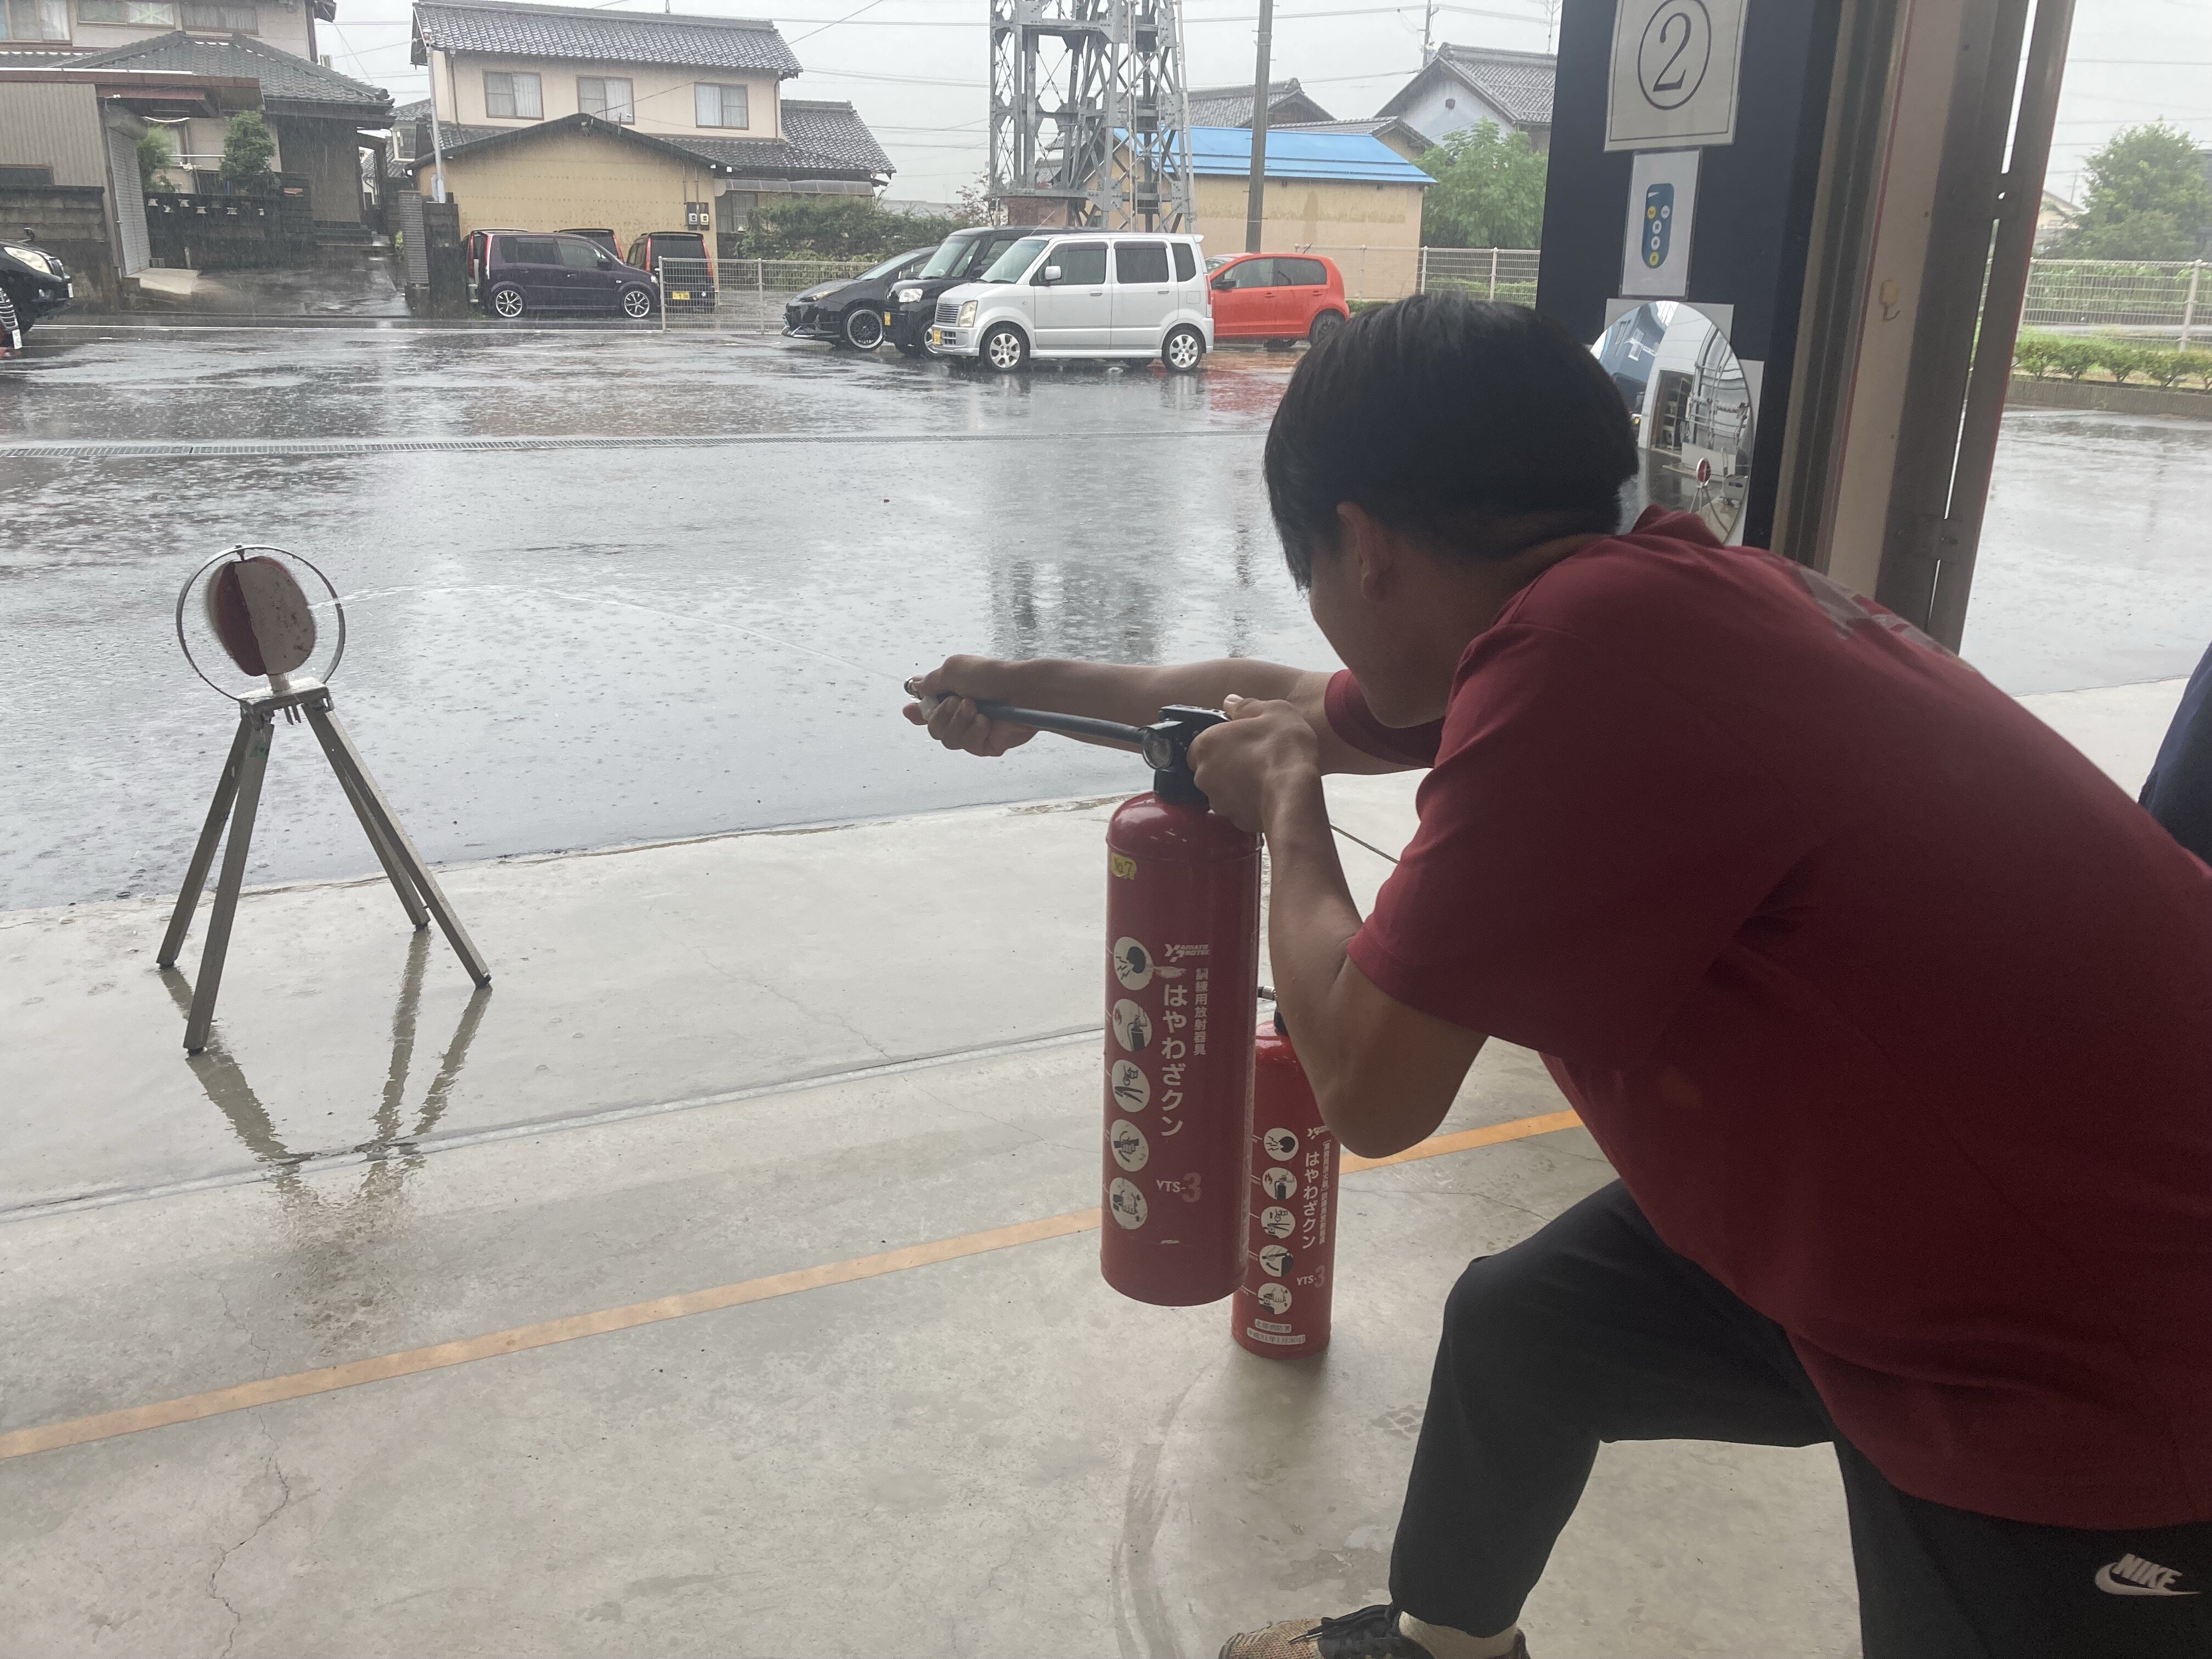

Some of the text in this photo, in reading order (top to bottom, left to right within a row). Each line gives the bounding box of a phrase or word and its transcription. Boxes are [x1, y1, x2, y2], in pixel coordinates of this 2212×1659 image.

[1161, 984, 1188, 1137] はやわざクン
[1302, 1152, 1319, 1249] はやわざクン
[1296, 1265, 1325, 1288] YTS-3
[2112, 1553, 2183, 1589] NIKE
